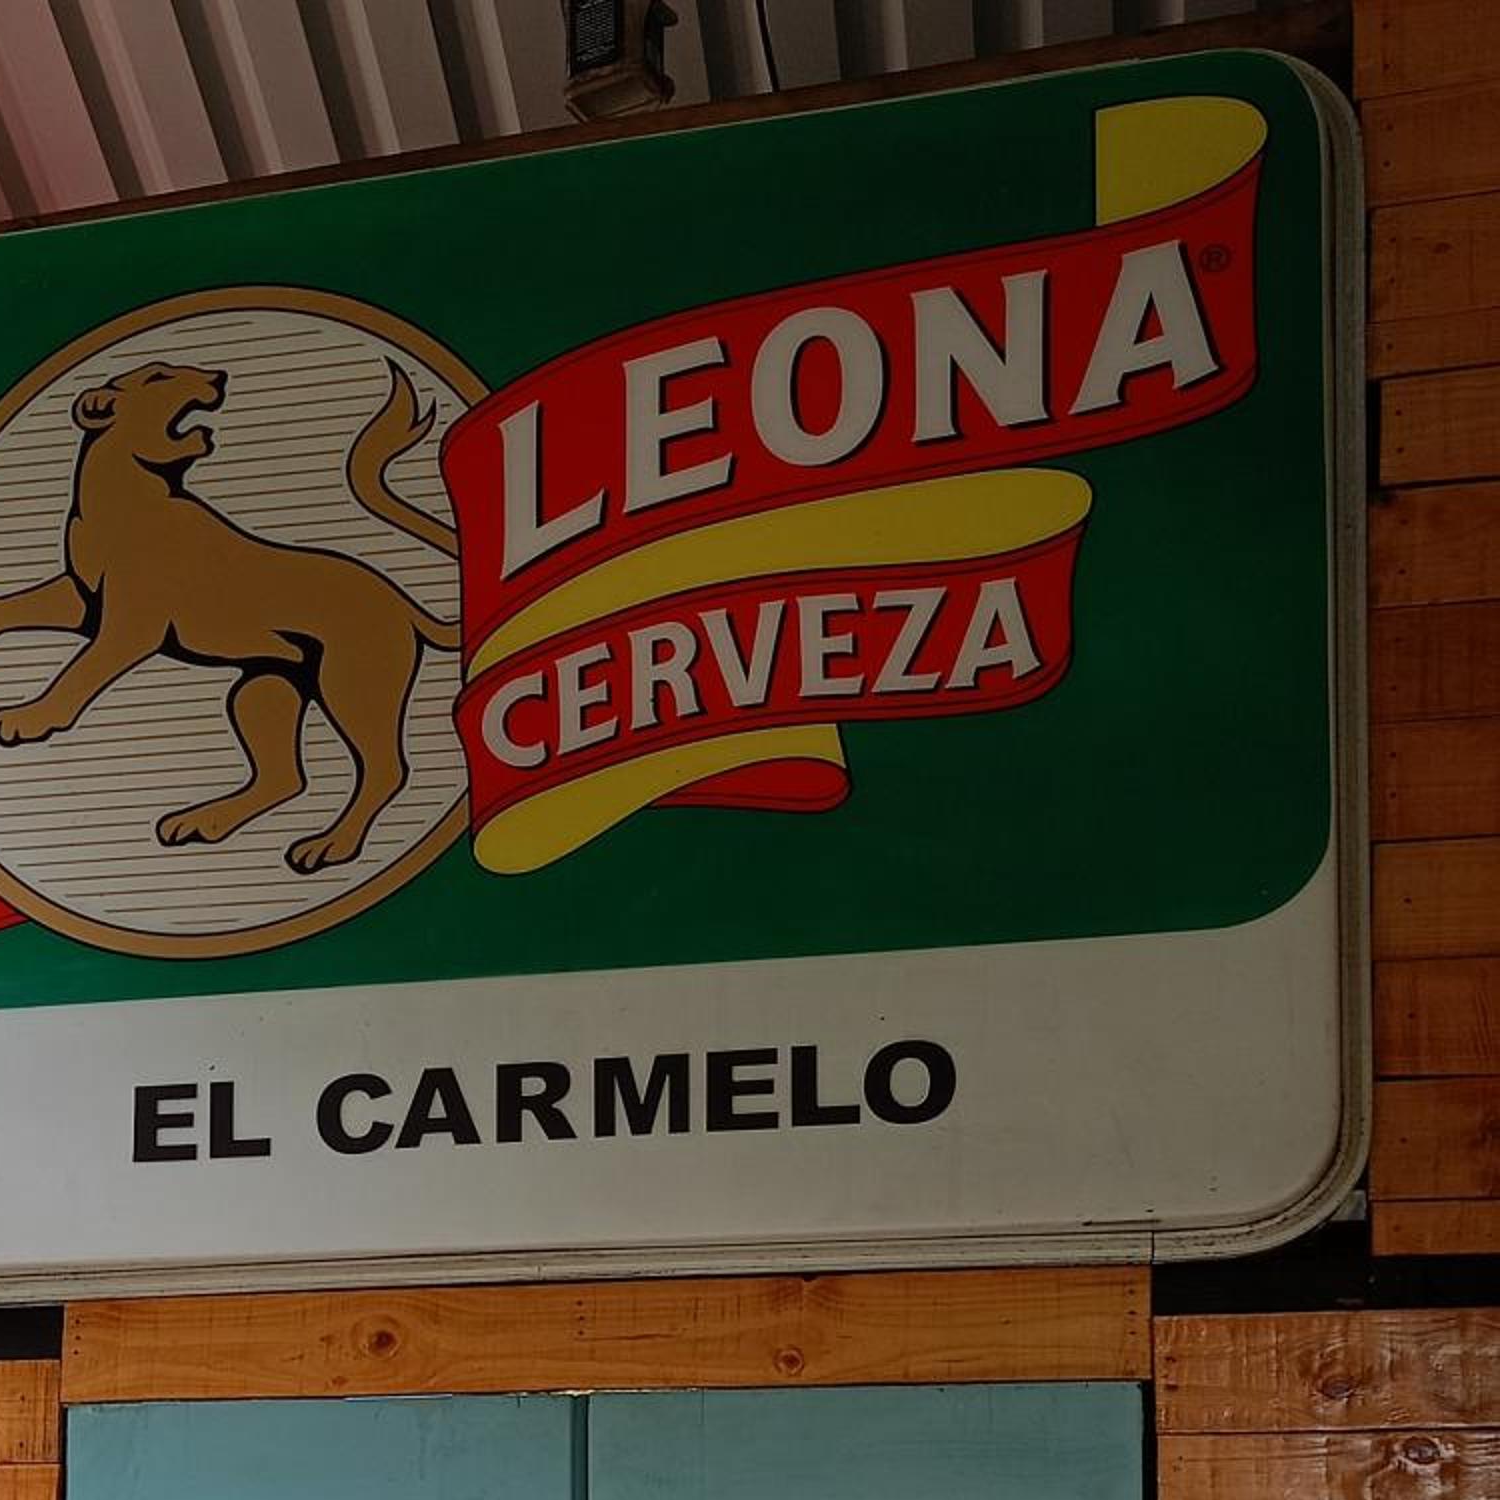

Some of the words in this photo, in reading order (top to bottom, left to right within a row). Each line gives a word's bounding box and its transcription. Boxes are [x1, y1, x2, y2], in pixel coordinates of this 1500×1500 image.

[498, 239, 1221, 582] LEONA
[480, 577, 1043, 768] CERVEZA
[131, 1082, 273, 1164] EL
[315, 1039, 958, 1156] CARMELO
